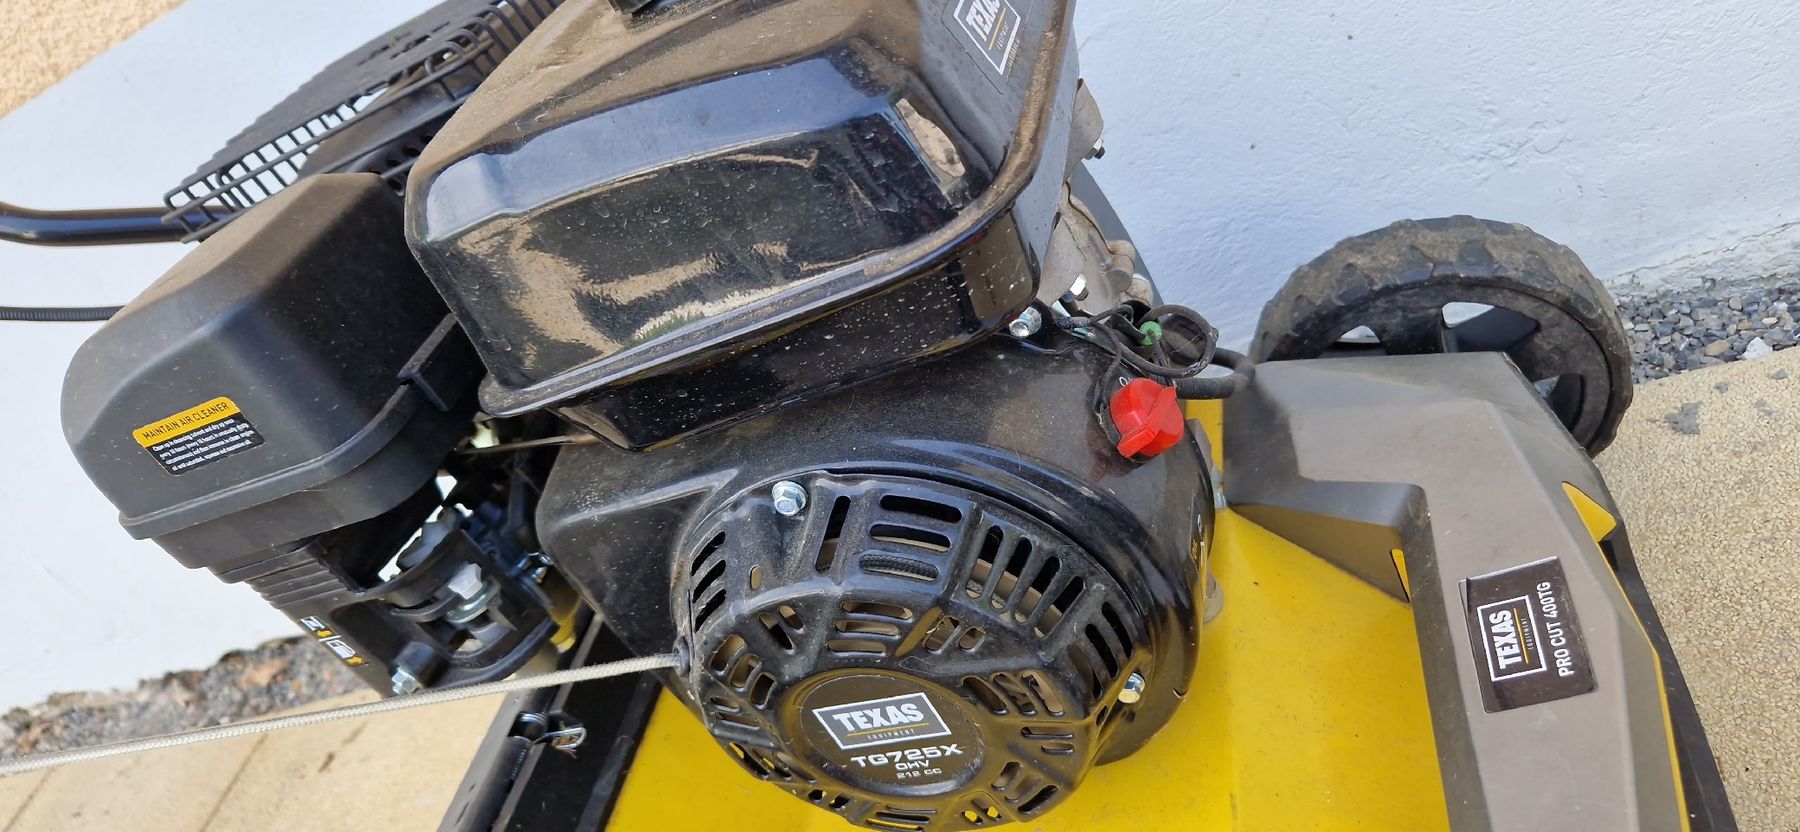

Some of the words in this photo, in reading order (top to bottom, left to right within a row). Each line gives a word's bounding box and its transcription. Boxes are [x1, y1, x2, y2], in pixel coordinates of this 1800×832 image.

[142, 420, 180, 440] MAINTAIN
[180, 415, 192, 426] AIR
[192, 402, 230, 420] CLEANER
[1536, 581, 1557, 618] 400TG
[1489, 609, 1522, 670] TEXAS
[1546, 622, 1567, 647] CUT
[1554, 648, 1575, 677] PRO
[832, 703, 924, 731] TEXAS
[850, 743, 964, 768] TG725X
[895, 760, 930, 771] OHV
[924, 767, 942, 775] CC
